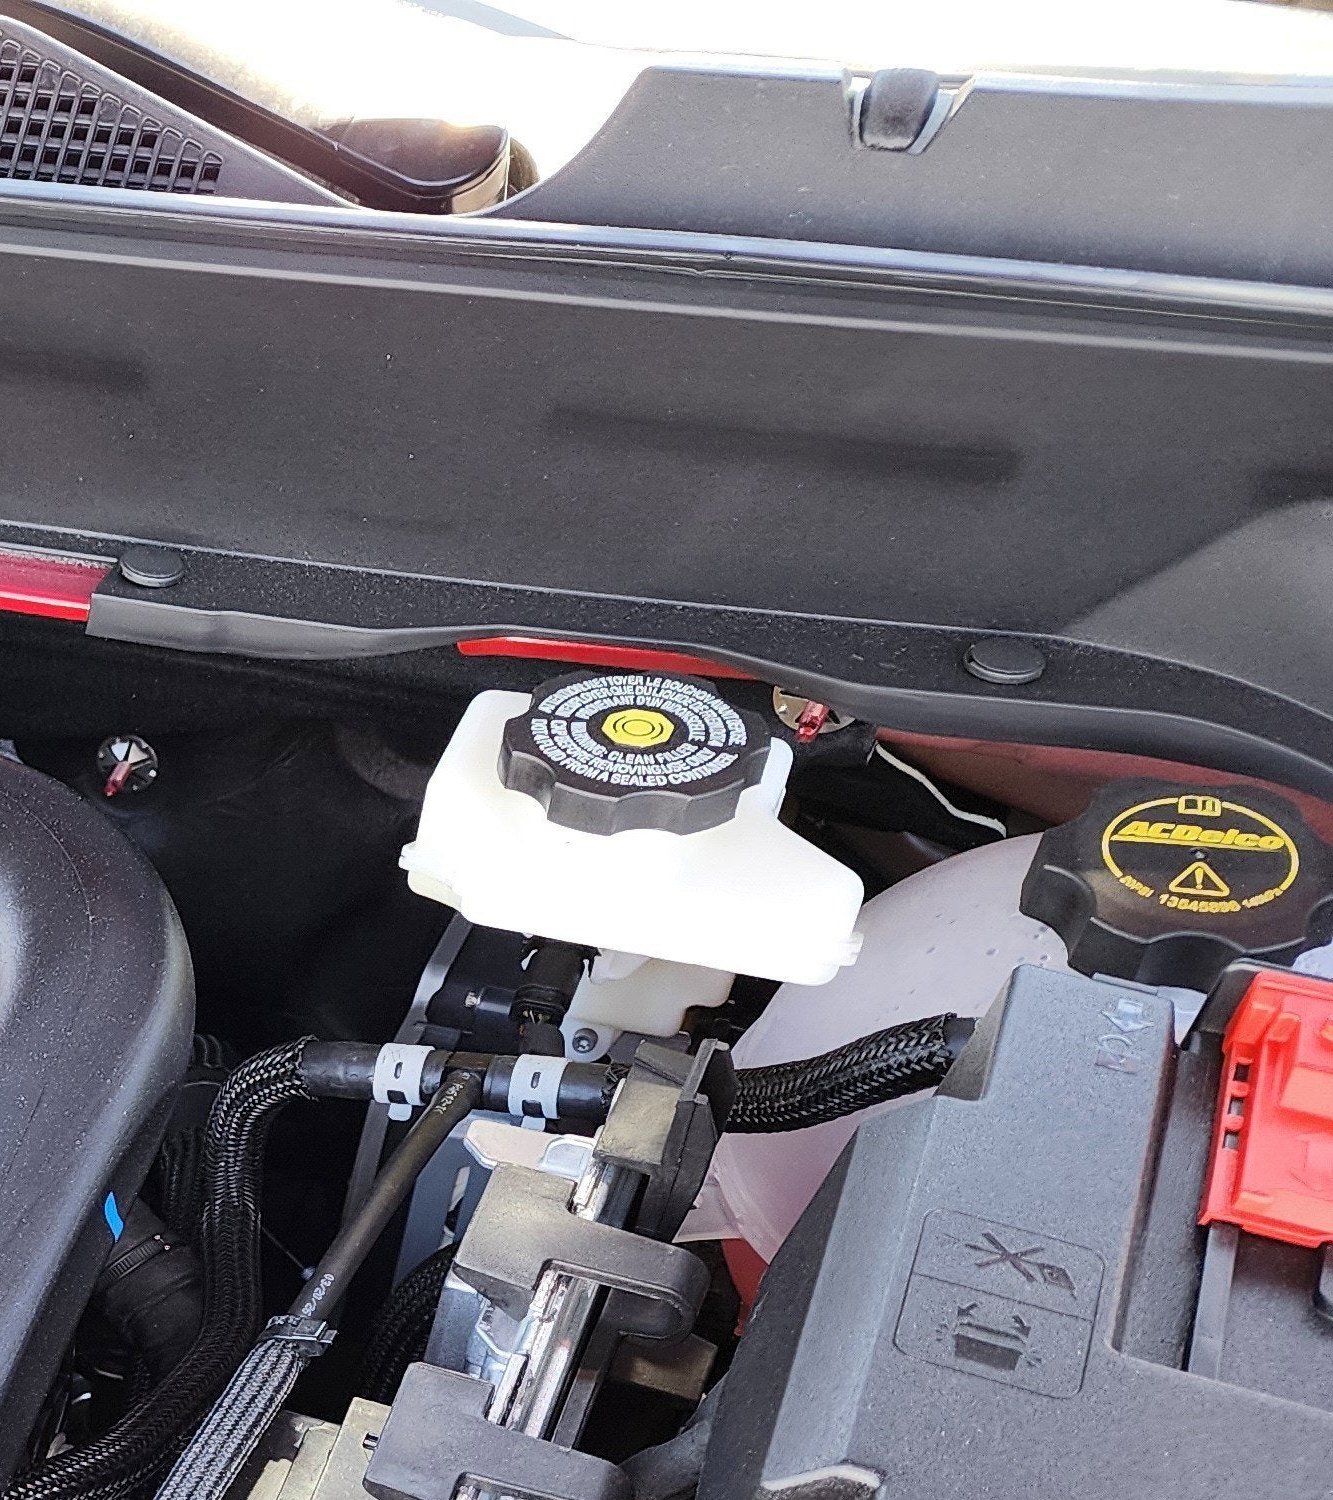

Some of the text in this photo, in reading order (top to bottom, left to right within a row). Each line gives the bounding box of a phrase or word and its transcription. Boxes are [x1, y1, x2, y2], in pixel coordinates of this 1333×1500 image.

[607, 685, 633, 695] QUE
[634, 685, 652, 696] DU
[651, 687, 698, 706] LIQUIDE
[660, 679, 716, 702] BOUCHON
[549, 718, 568, 735] CAP
[551, 735, 594, 764] BEFORE
[602, 752, 657, 766] CLEAN
[535, 739, 569, 761] FLUID
[556, 757, 600, 778] FROM
[596, 771, 610, 781] A
[608, 773, 670, 786] SEALED
[1117, 820, 1285, 850] ACDelco
